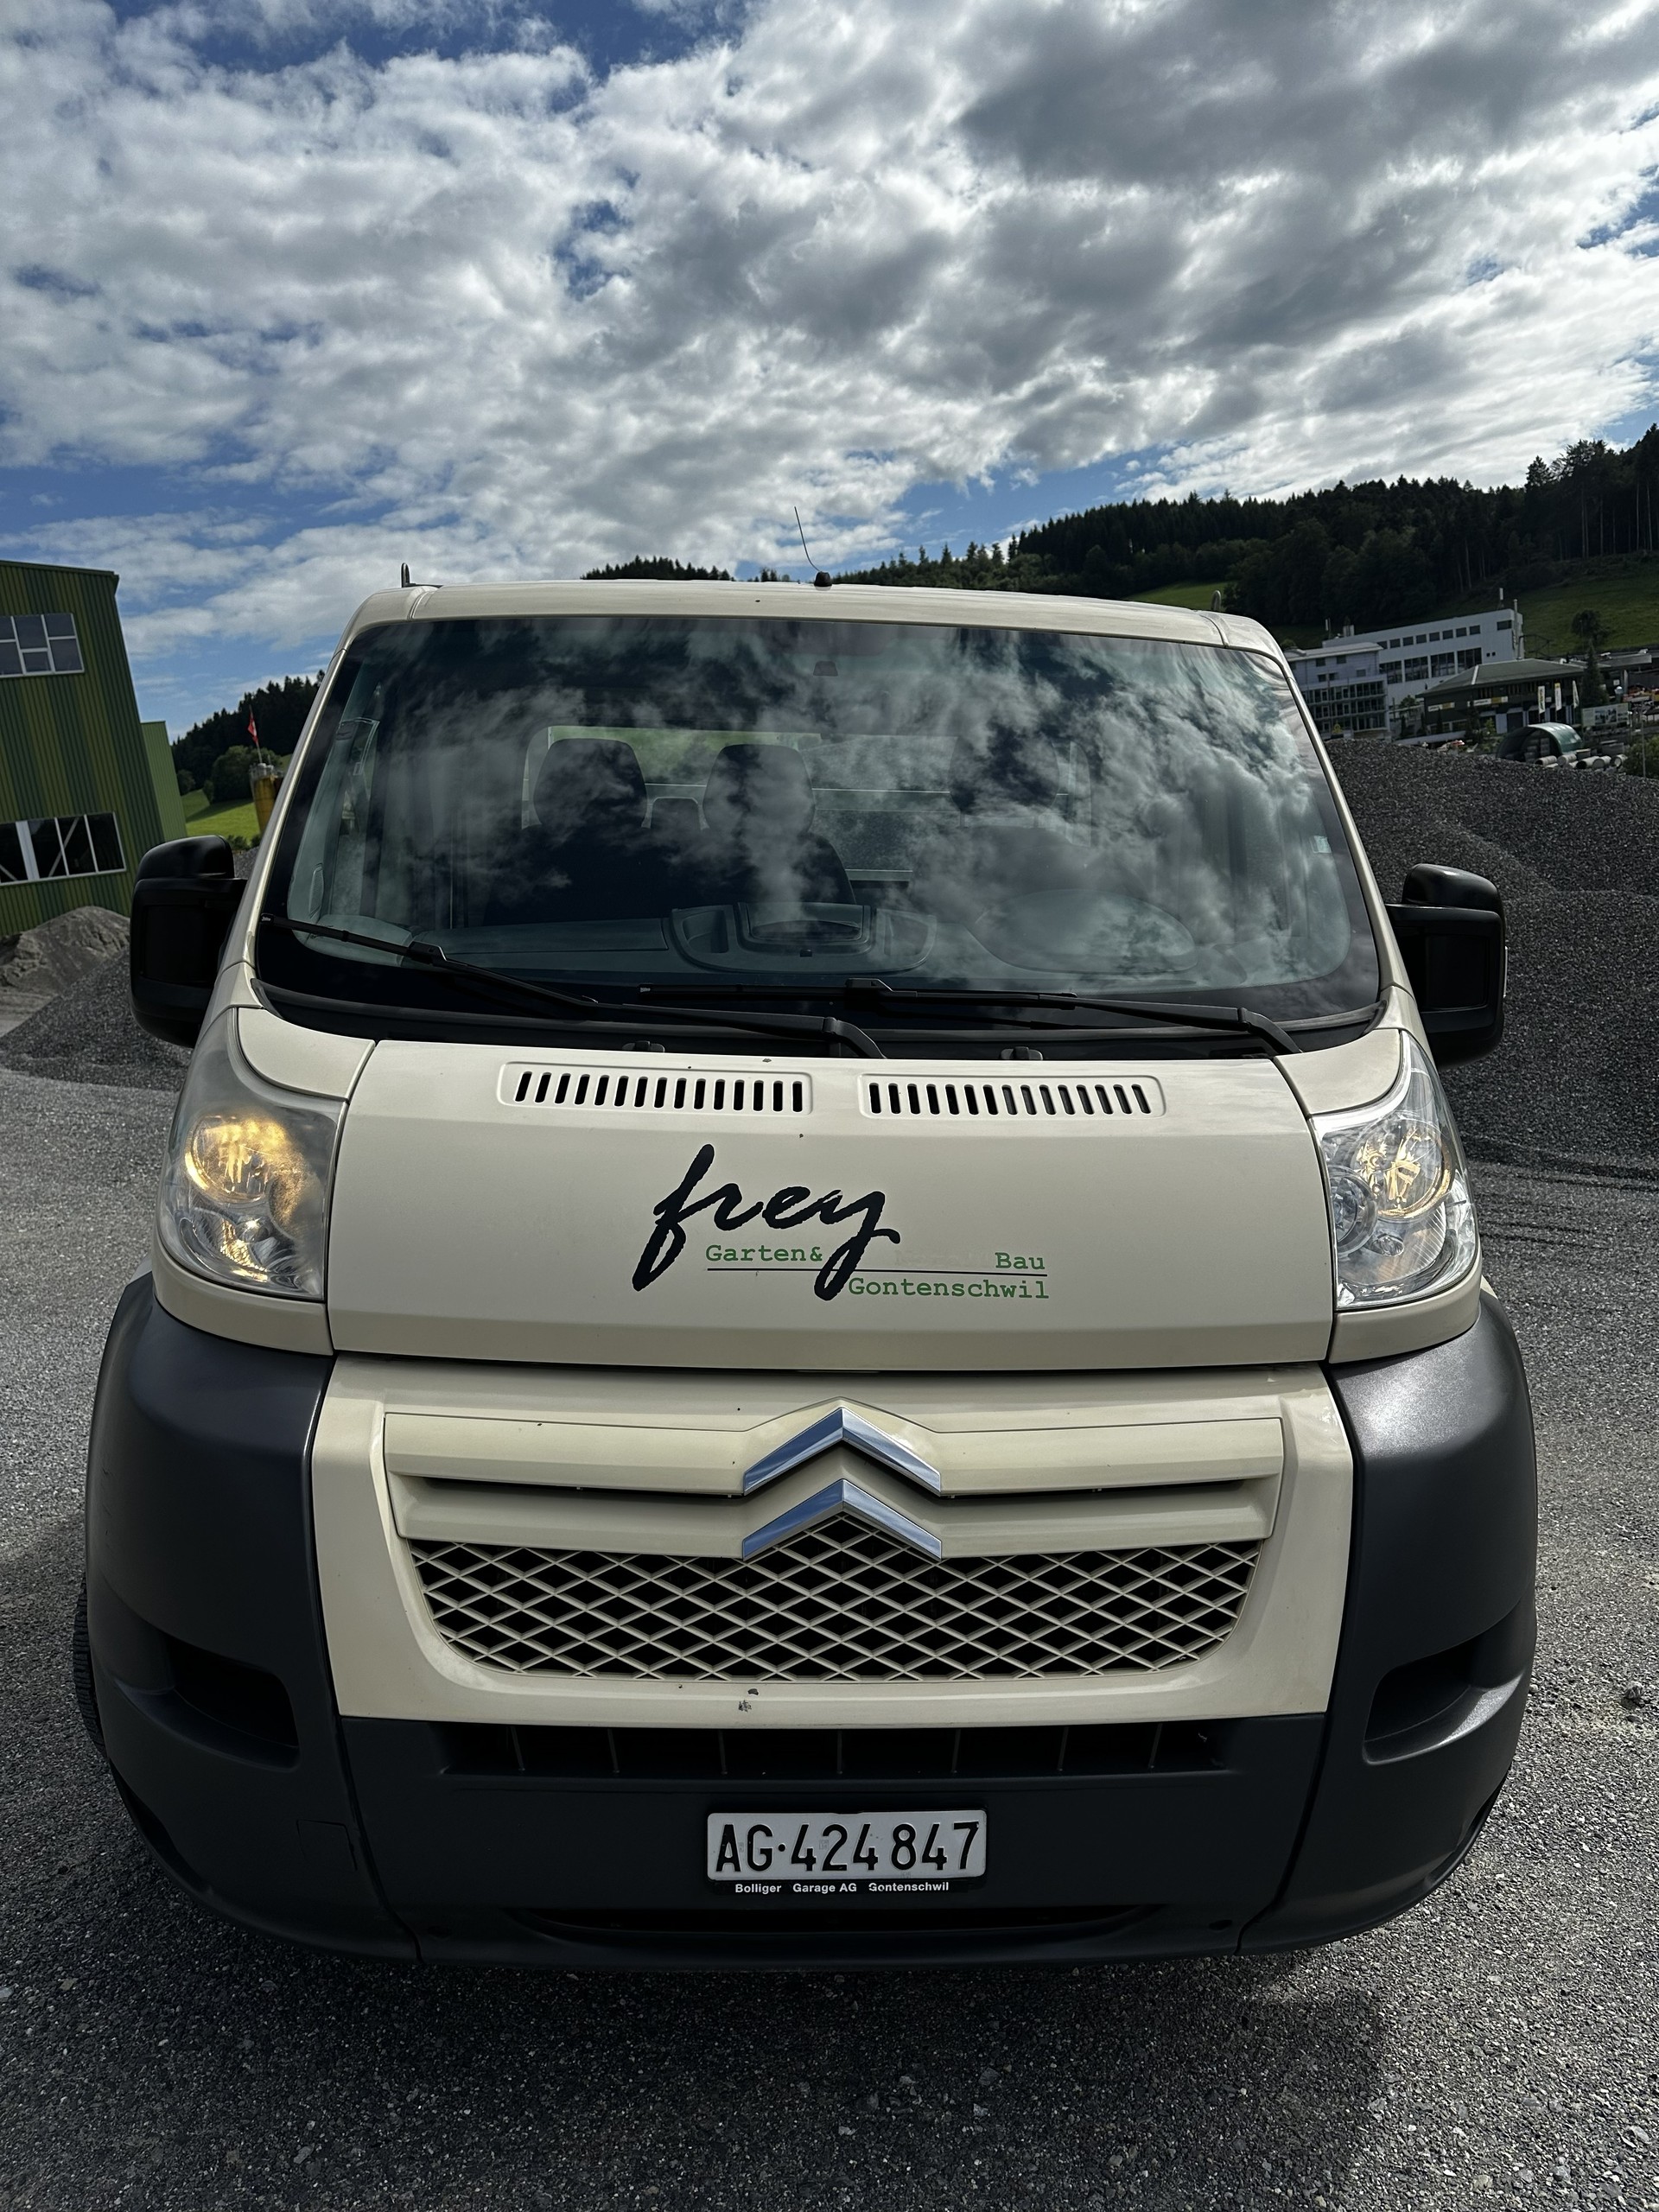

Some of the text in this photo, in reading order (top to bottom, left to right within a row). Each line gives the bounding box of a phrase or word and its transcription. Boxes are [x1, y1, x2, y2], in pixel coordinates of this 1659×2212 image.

[632, 1144, 900, 1301] frey
[995, 1252, 1046, 1270] Bau
[848, 1277, 1049, 1300] Gontenschwil
[734, 1881, 950, 1895] Bolliger Garage AG Gontenschwil
